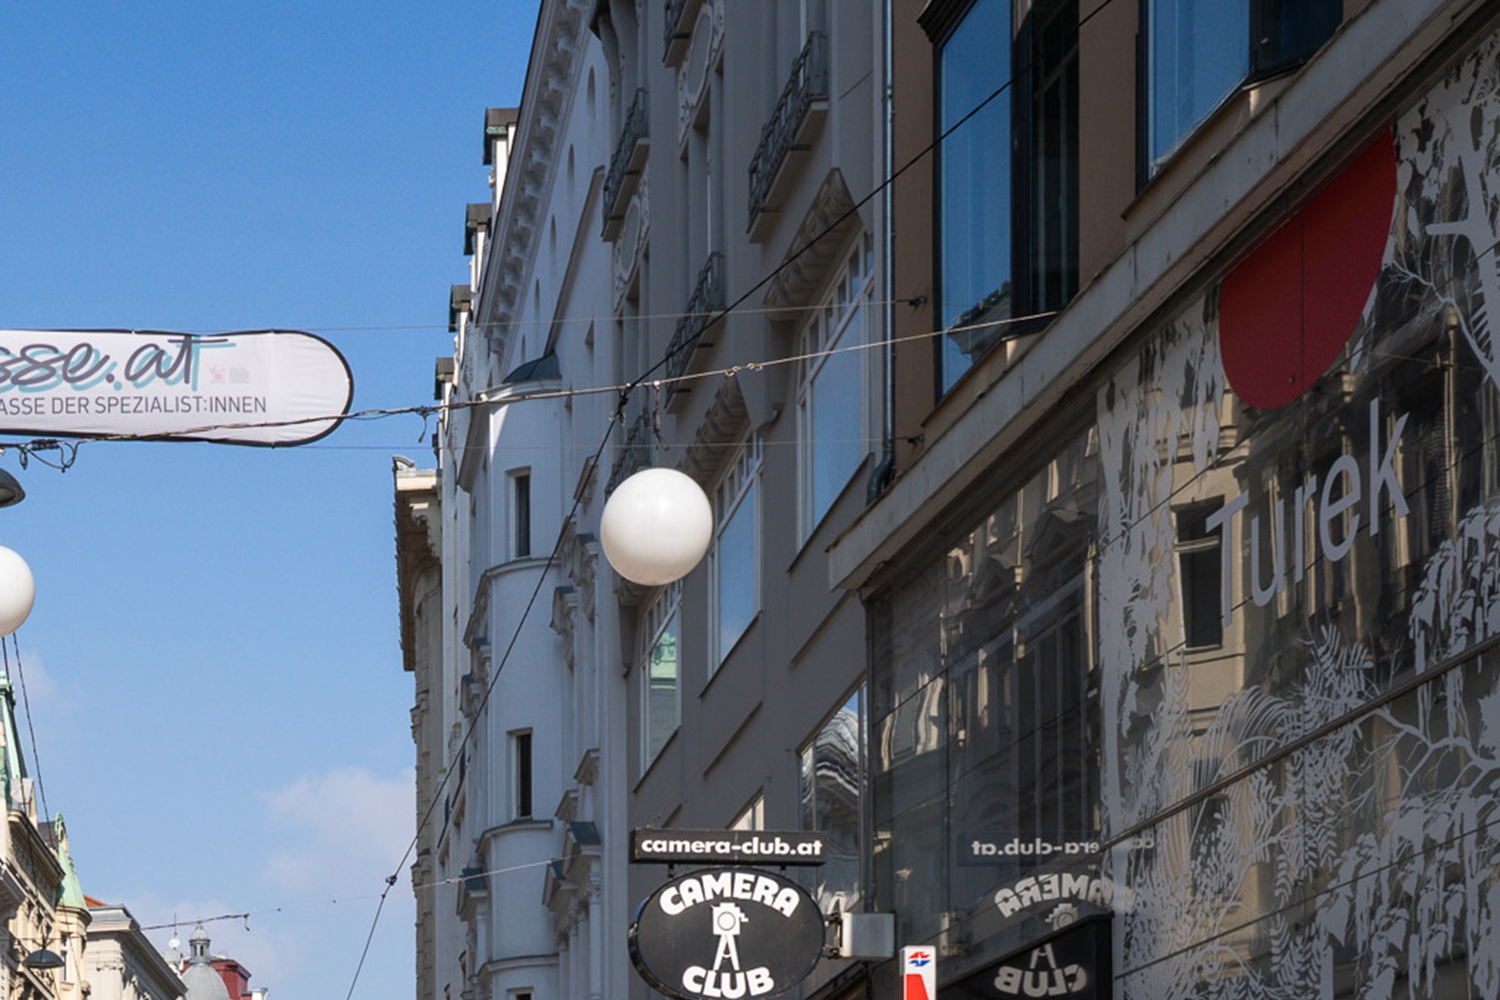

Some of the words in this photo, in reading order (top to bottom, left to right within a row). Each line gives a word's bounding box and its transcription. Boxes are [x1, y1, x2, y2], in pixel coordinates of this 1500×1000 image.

[52, 397, 90, 415] DER
[94, 396, 267, 414] SPEZIALIST:INNEN
[1205, 399, 1410, 628] Turek
[641, 837, 823, 856] camera-club.at
[659, 872, 800, 918] CAMERA
[682, 965, 774, 999] CLUB
